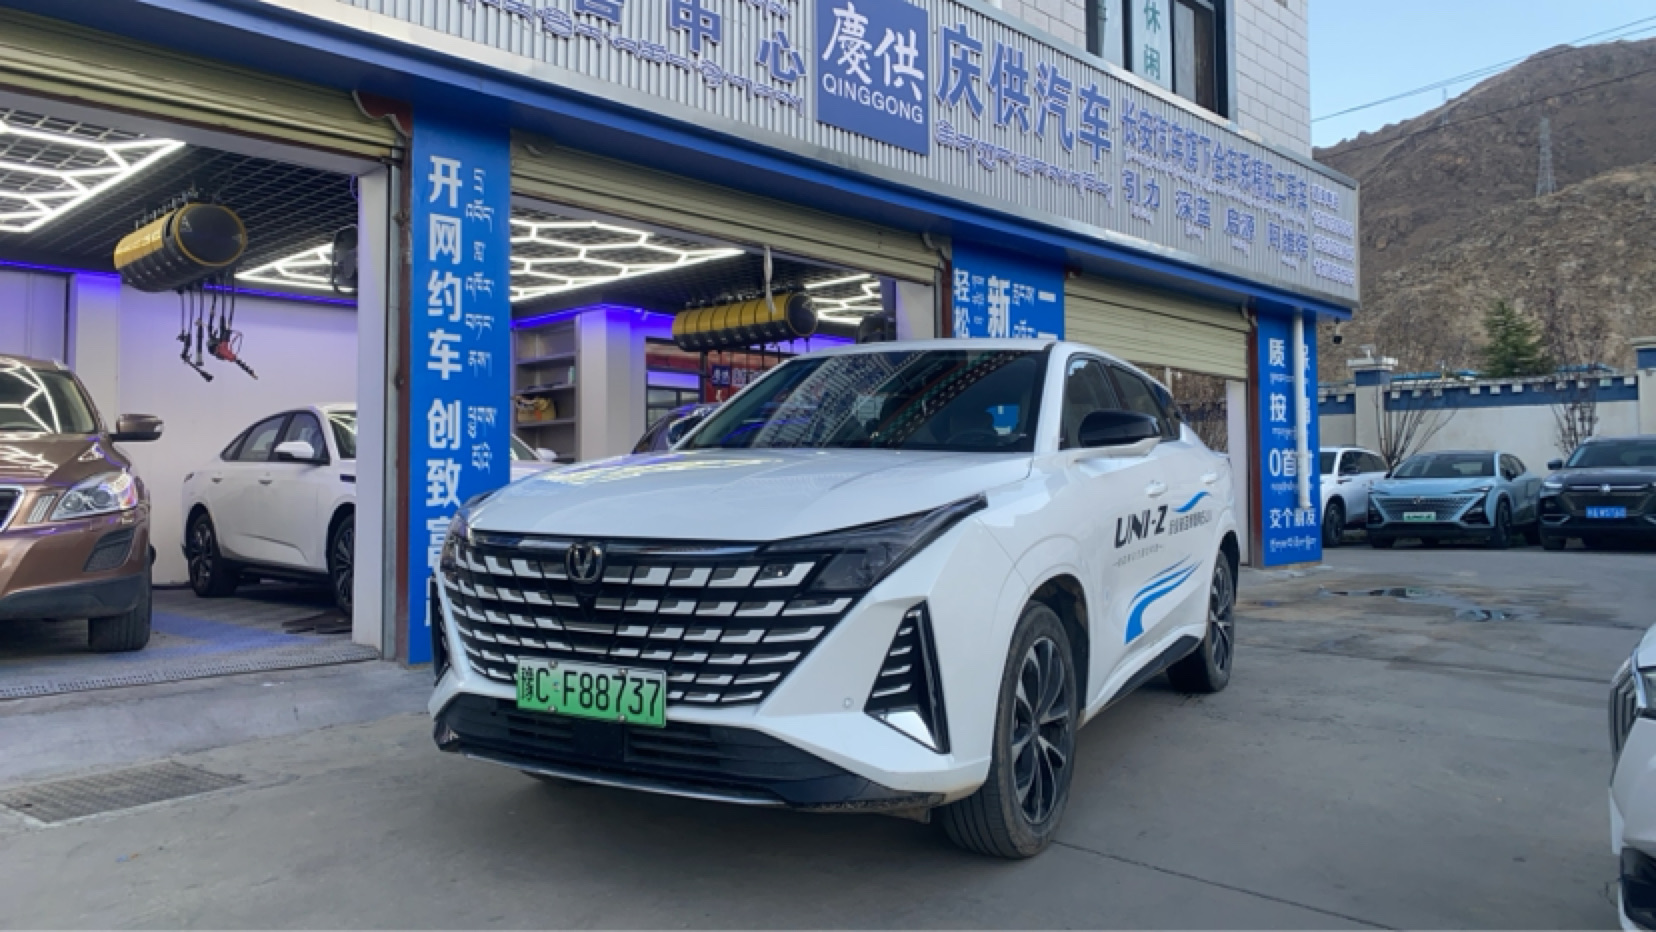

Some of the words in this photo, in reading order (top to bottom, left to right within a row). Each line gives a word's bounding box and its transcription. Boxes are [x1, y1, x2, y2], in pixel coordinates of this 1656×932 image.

[822, 73, 924, 125] QINGGONG
[936, 23, 1111, 163] 庆供汽车
[1121, 168, 1161, 210] 引力
[1175, 189, 1212, 229] 深蓝
[427, 155, 463, 381] 开网约车
[953, 268, 970, 338] 轻松
[987, 276, 1011, 338] 新
[1114, 503, 1169, 549] UNI-Z
